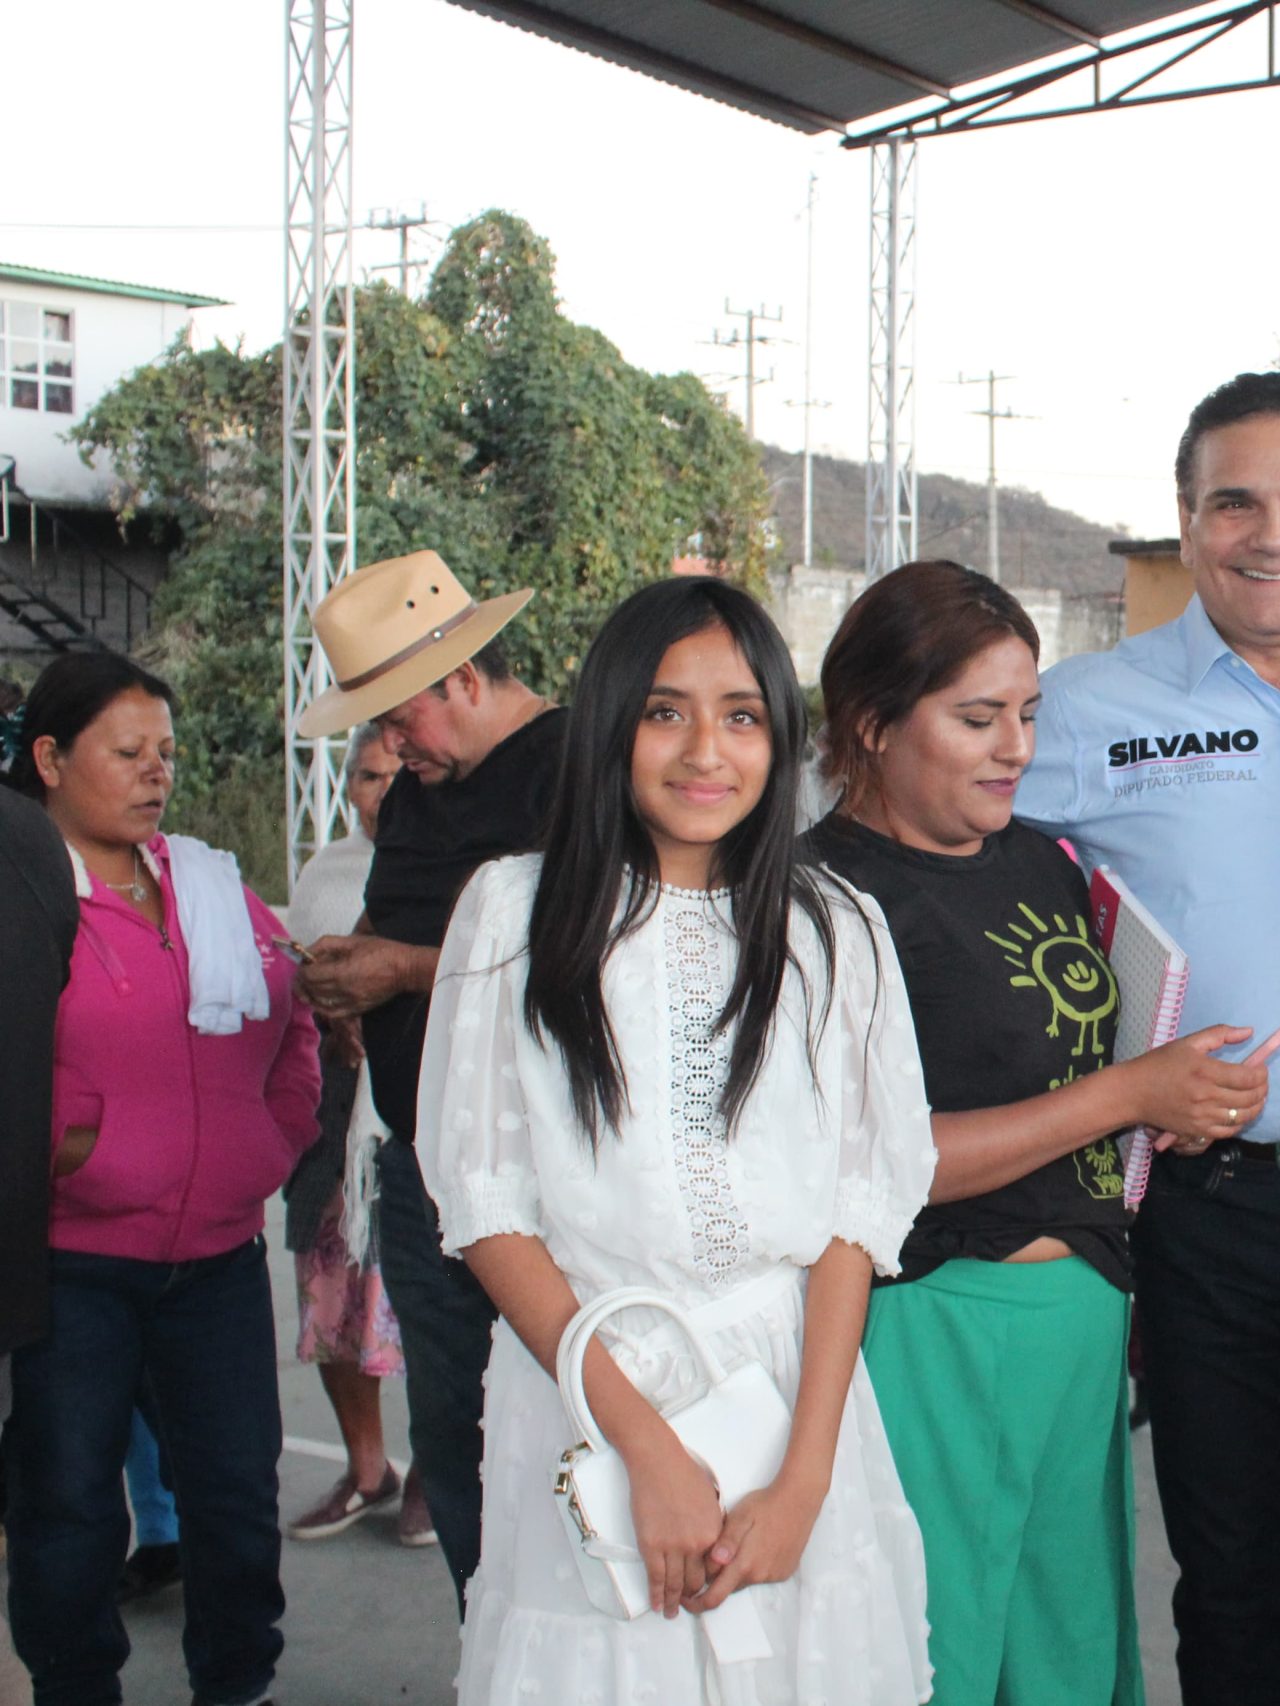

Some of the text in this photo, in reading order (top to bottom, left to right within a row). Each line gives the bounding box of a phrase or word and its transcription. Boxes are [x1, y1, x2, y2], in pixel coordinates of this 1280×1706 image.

[1108, 729, 1259, 768] SILVANO
[1150, 760, 1215, 775] CANDIDATO
[1114, 769, 1257, 798] DIPUTADO FEDERAL
